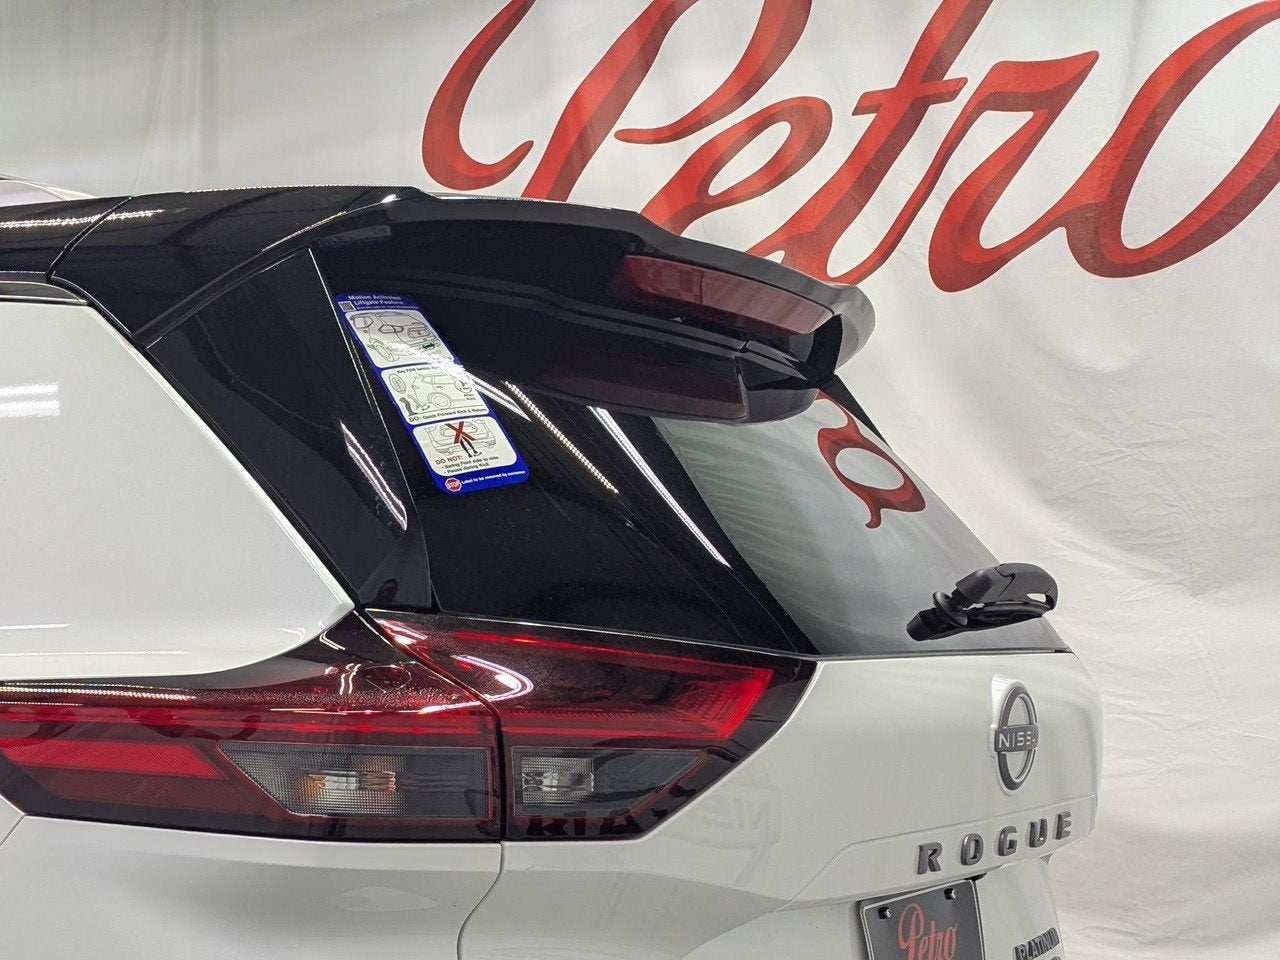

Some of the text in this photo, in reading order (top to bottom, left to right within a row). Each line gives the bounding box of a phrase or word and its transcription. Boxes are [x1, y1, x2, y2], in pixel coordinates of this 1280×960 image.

[421, 0, 1280, 293] Petro
[998, 730, 1037, 748] NISS
[917, 811, 1072, 875] ROGUE
